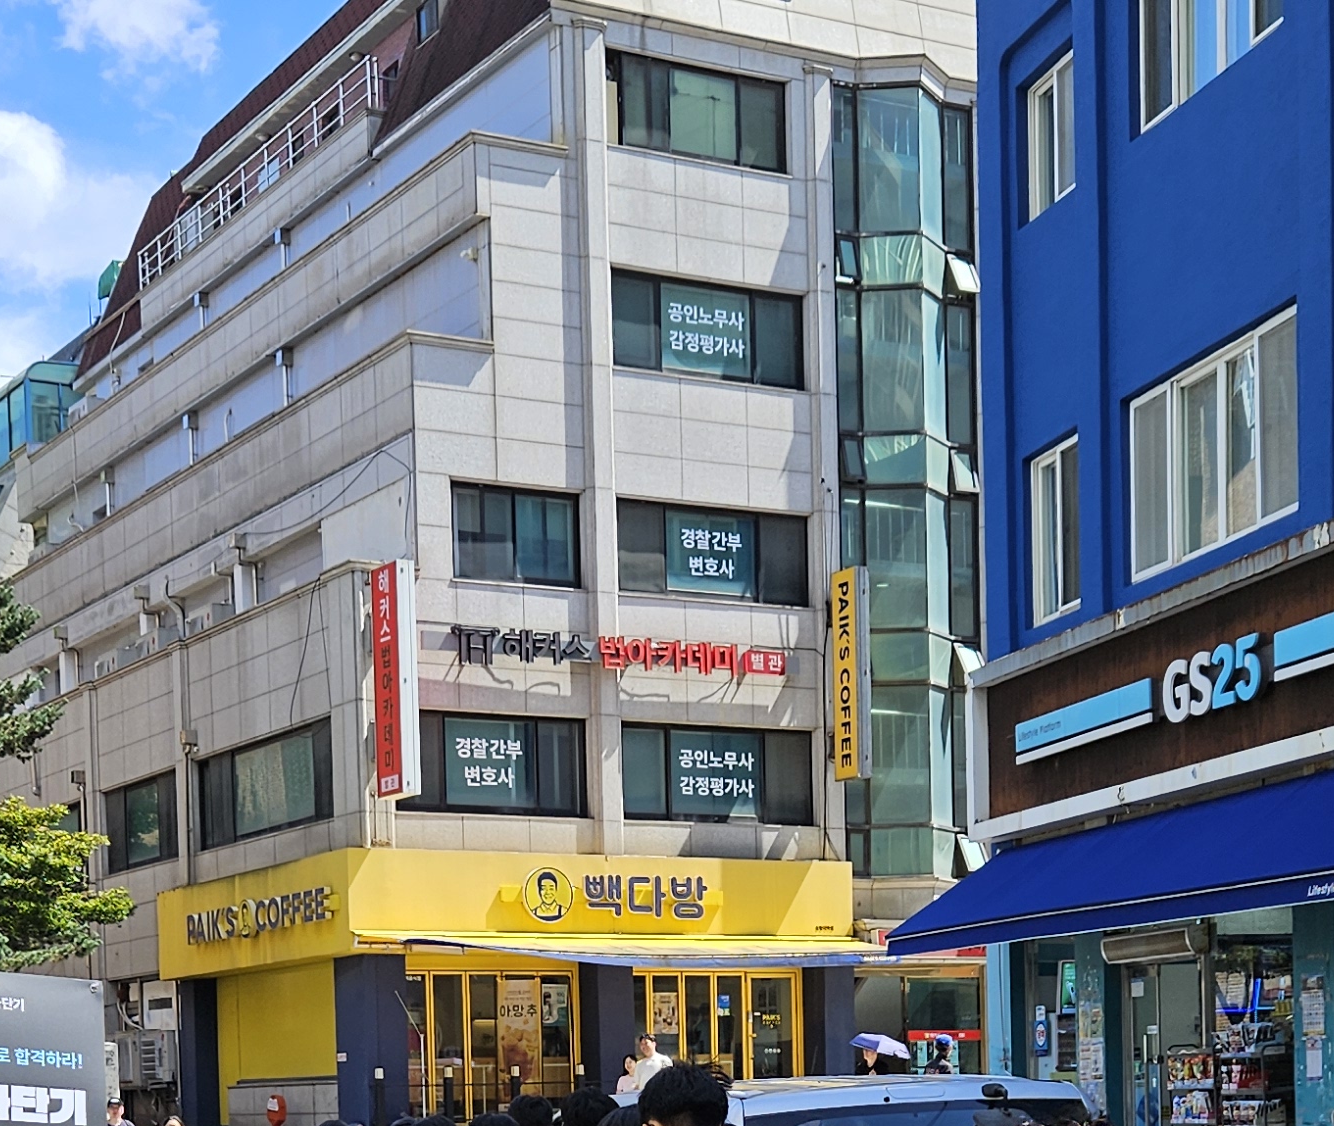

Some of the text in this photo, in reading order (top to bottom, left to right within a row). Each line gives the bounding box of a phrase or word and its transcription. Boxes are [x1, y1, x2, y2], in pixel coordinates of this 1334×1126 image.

[667, 302, 745, 331] 공인노무사
[668, 330, 745, 358] 감정평가사
[680, 528, 743, 553] 경찰간부
[688, 555, 735, 580] 변호사
[378, 568, 392, 643] 해커스
[503, 629, 592, 666] 해커스
[598, 635, 739, 677] 법아카데미
[750, 651, 783, 671] 별관
[838, 580, 852, 768] PAIK'S COFFEE
[1162, 631, 1263, 724] GS25
[380, 644, 395, 772] 법아카데미
[455, 736, 523, 760] 경찰간부
[678, 749, 755, 773] 공인노무사
[464, 764, 515, 789] 변호사
[679, 775, 755, 799] 감정평가사
[582, 873, 708, 920] 빽다방
[187, 886, 333, 945] PAIK'S COFFEE
[499, 1004, 538, 1018] 아.망.추
[14, 1047, 83, 1070] 합격하라!
